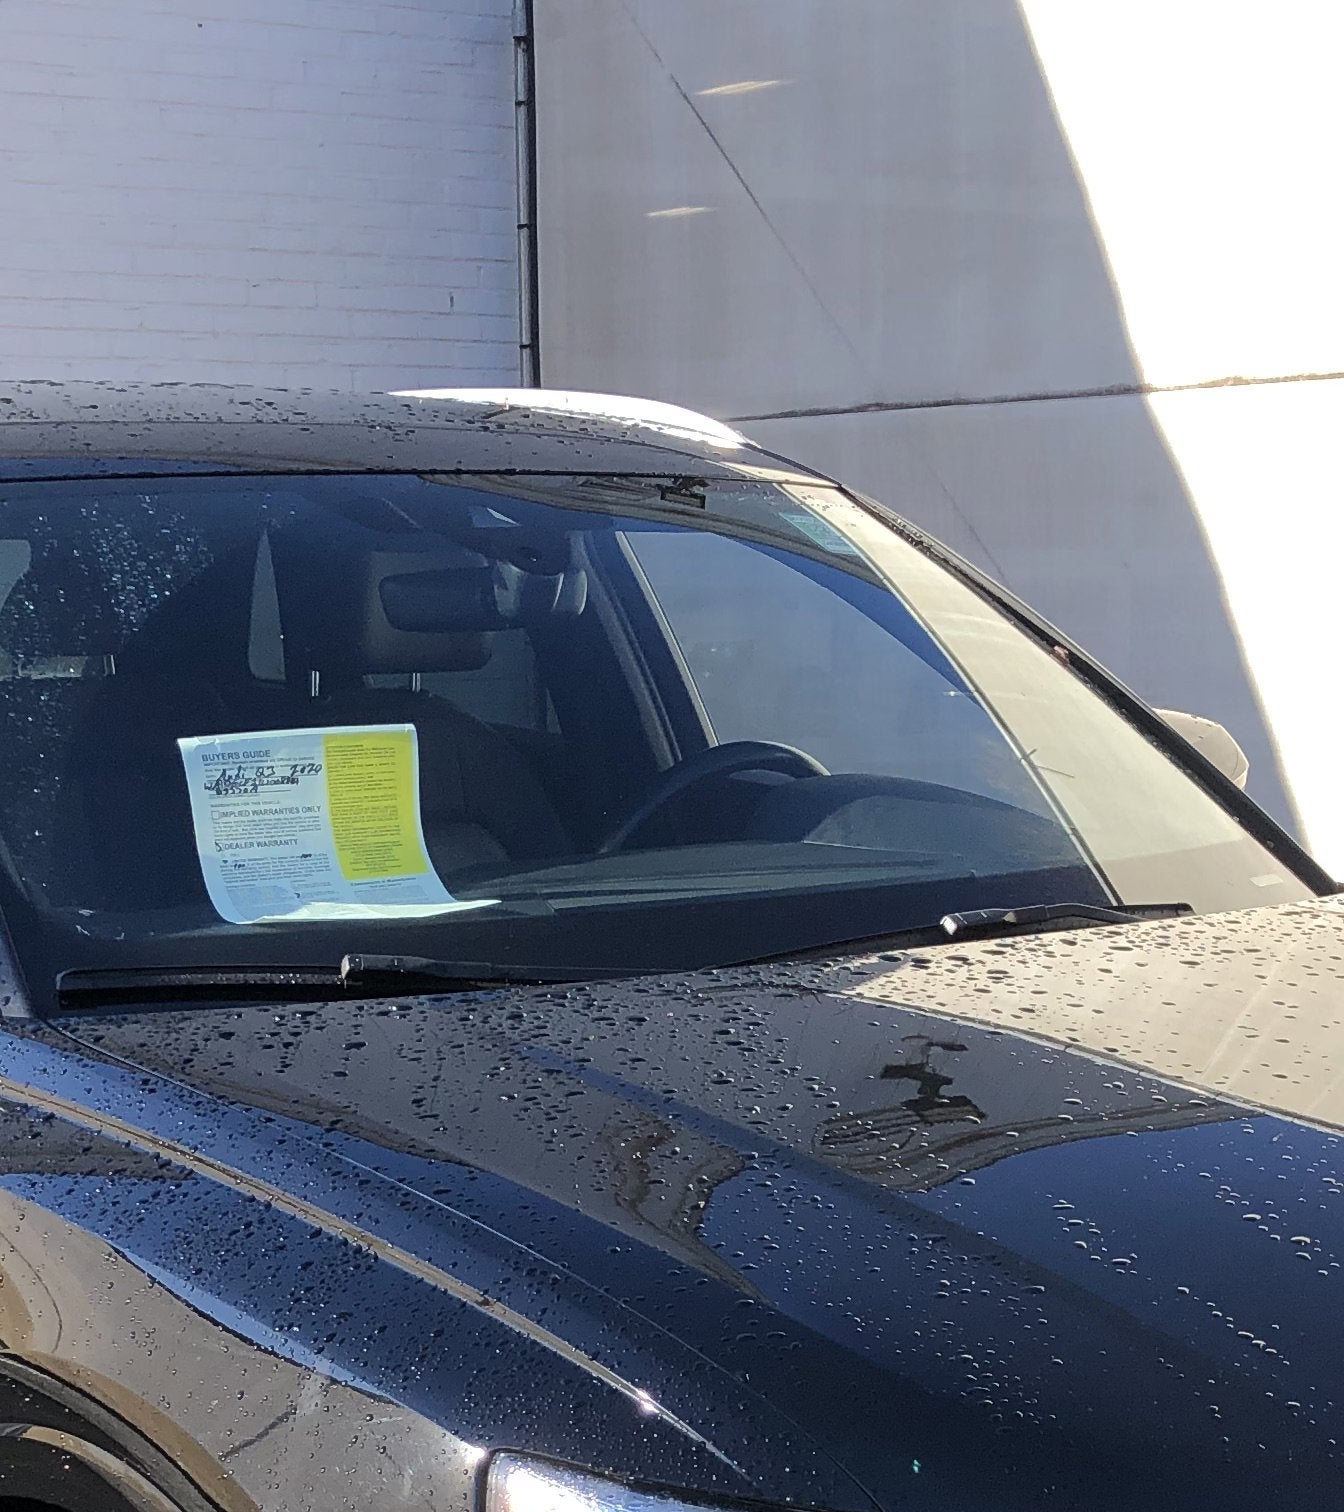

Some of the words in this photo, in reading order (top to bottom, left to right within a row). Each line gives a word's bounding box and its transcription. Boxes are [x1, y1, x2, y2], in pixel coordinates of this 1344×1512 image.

[201, 751, 241, 762] BUYERS
[242, 749, 271, 759] GUIDE
[220, 809, 250, 818] IMPLIED
[251, 807, 300, 816] WARRANTIES
[301, 805, 322, 814] ONLY
[224, 842, 255, 850] DEALER
[256, 838, 299, 849] WARRANTY
